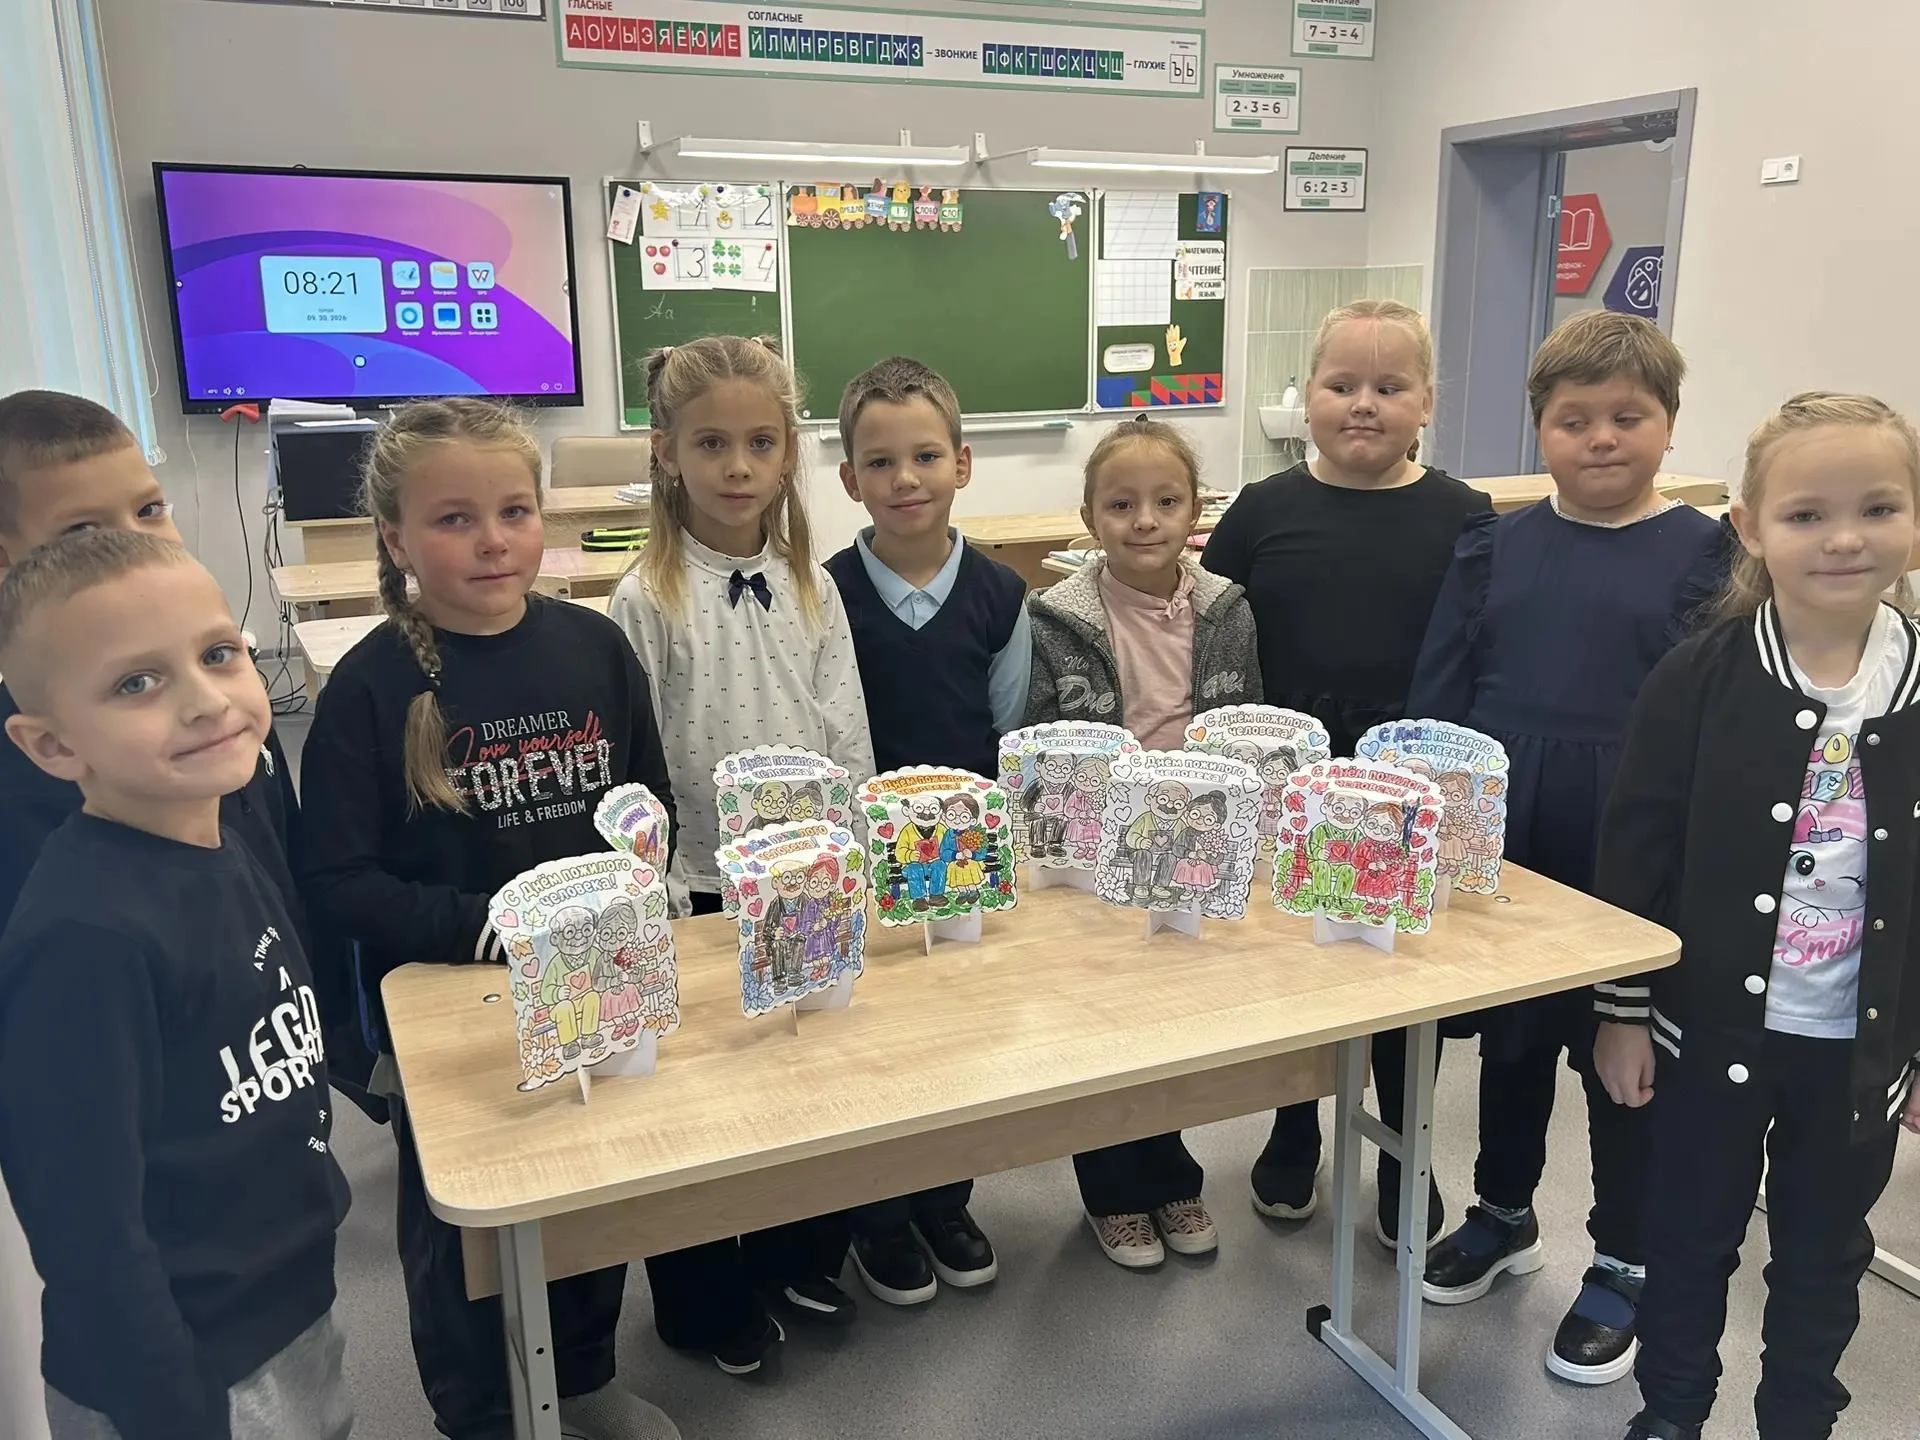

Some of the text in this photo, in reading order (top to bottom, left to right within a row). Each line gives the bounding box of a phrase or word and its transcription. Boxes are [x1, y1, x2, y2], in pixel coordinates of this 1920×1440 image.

[568, 0, 613, 11] ГЛАСНЫЕ
[748, 11, 803, 23] СОГЛАСНЫЕ
[935, 49, 978, 60] ЗВОНКИЕ
[1133, 60, 1166, 71] ГЛУХИЕ
[1232, 69, 1285, 81] Умножение
[1308, 152, 1346, 161] Деление
[754, 195, 772, 226] 2
[687, 247, 705, 278] 3
[1188, 265, 1222, 275] ЧТЕНИЕ
[284, 271, 357, 295] 08:21
[1064, 655, 1089, 670] My
[481, 710, 572, 741] DREAMER
[1204, 712, 1313, 731] С Днём пожилого
[446, 710, 615, 767] Love yourself
[1069, 729, 1125, 742] пожилого
[1228, 726, 1296, 740] человека!
[1378, 726, 1494, 754] С Днём пожилого
[1042, 739, 1108, 749] человека!
[445, 738, 612, 811] FOREVER
[725, 754, 826, 774] С Днём пожилого
[751, 768, 815, 779] человека!
[1129, 755, 1247, 778] С Днём пожилого
[882, 776, 917, 791] Днём
[917, 775, 975, 784] пожилого
[1154, 768, 1228, 784] человека!
[1311, 765, 1430, 794] С Днём пожилого
[1334, 779, 1409, 798] человека!
[498, 812, 520, 829] LIFE
[524, 808, 535, 824] &
[536, 799, 587, 821] FREEDOM
[756, 837, 820, 860] человека!
[503, 858, 633, 907] С Днём пожилого
[538, 873, 618, 908] человека!
[1773, 920, 1857, 966] Smil
